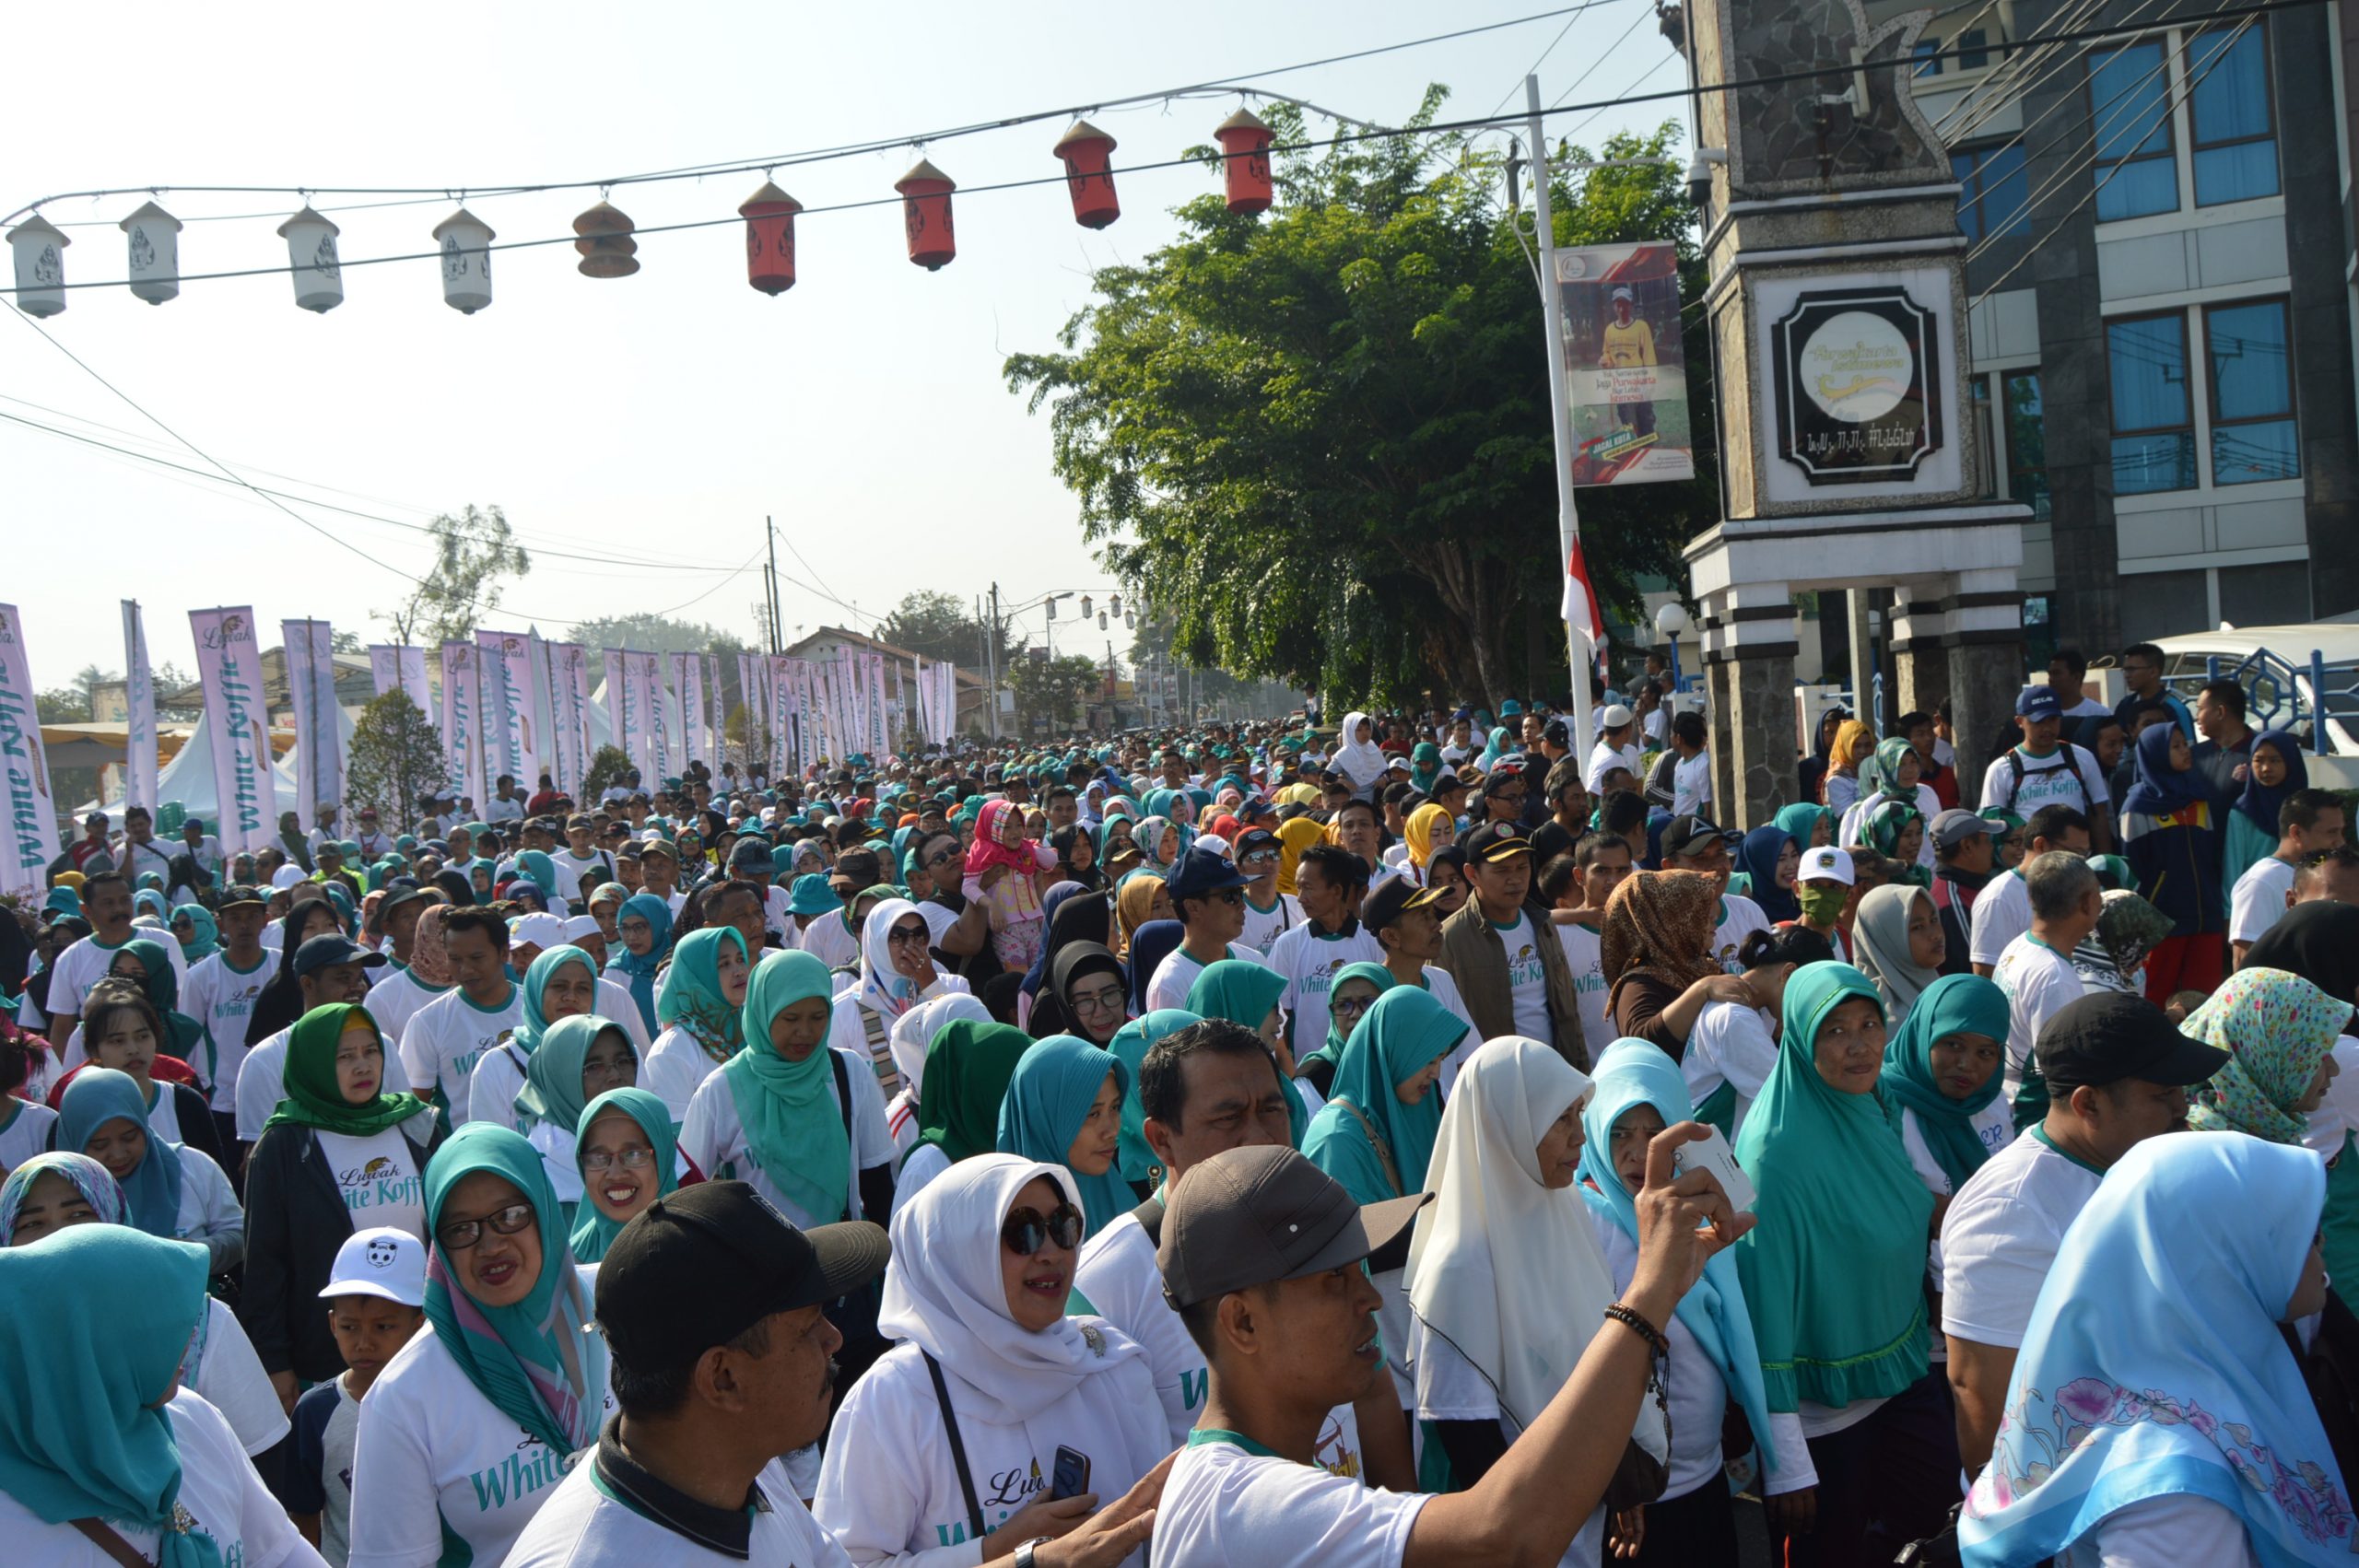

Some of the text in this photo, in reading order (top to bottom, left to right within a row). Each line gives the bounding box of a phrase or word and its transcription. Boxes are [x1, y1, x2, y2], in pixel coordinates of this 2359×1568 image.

[1613, 376, 1657, 386] Purwakarta
[219, 653, 262, 834] White Koffie
[2018, 785, 2049, 802] White
[215, 1001, 247, 1017] White
[338, 1164, 401, 1187] Luwak
[344, 1188, 371, 1210] ite
